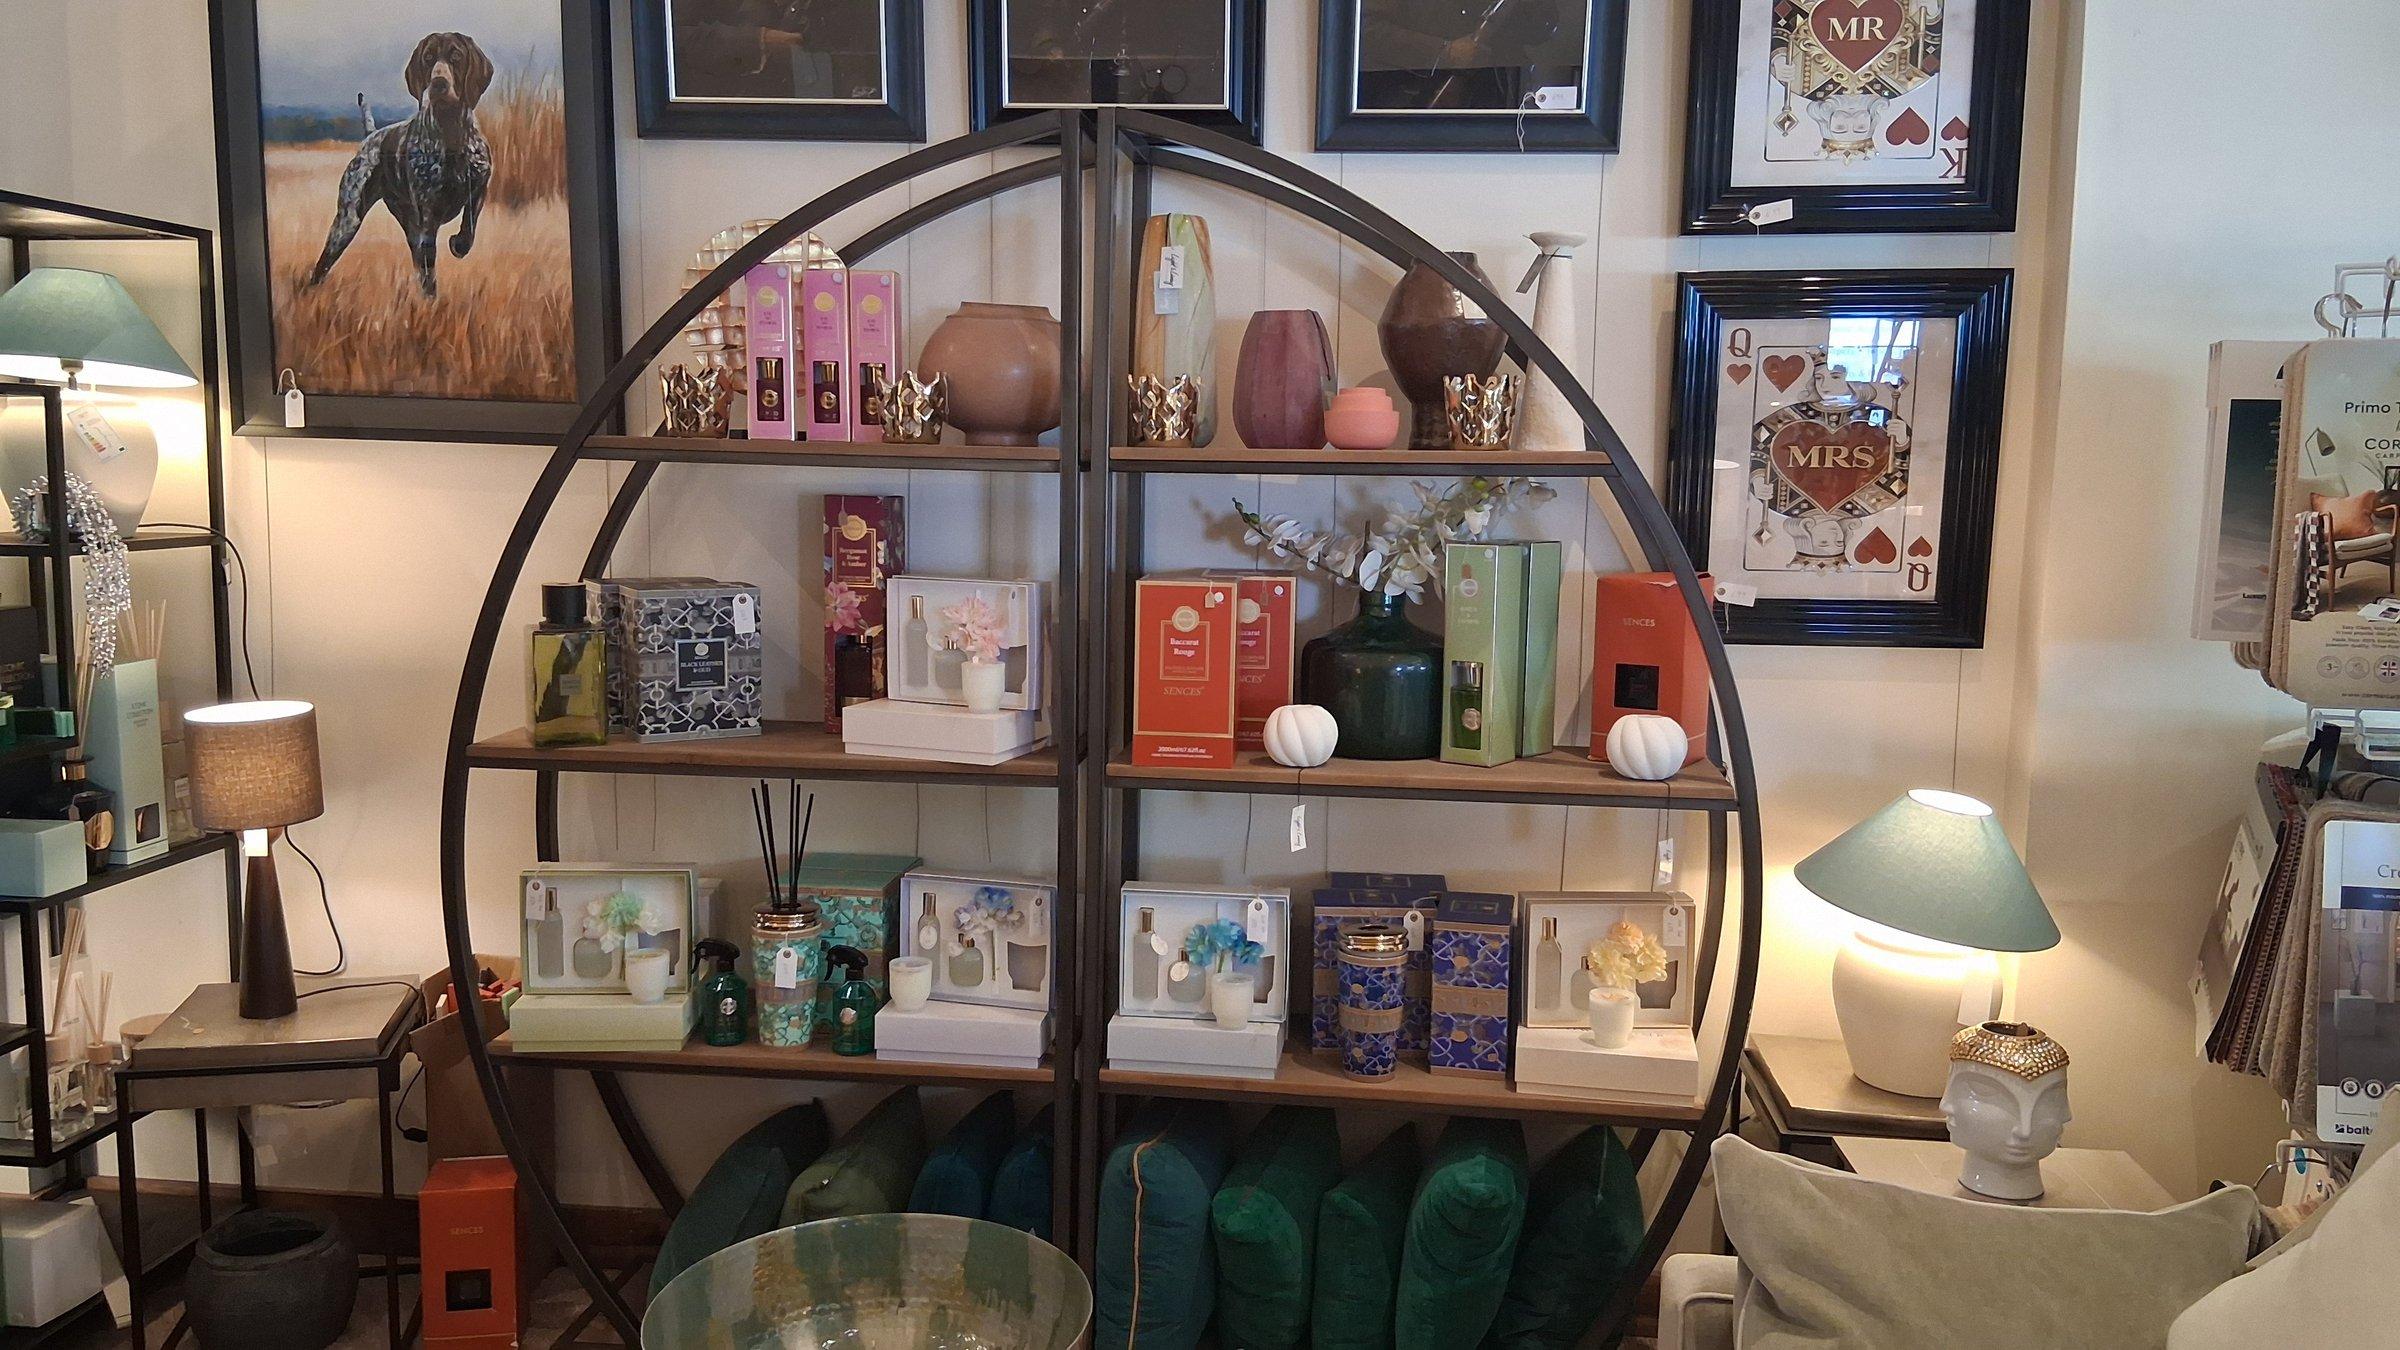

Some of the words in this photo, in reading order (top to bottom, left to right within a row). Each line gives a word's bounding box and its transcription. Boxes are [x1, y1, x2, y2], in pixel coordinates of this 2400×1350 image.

[1827, 16, 1886, 42] MR
[1938, 147, 1967, 179] K
[1727, 327, 1752, 358] Q
[2344, 400, 2391, 413] Primo
[1787, 445, 1875, 469] MRS
[1907, 562, 1932, 591] Q
